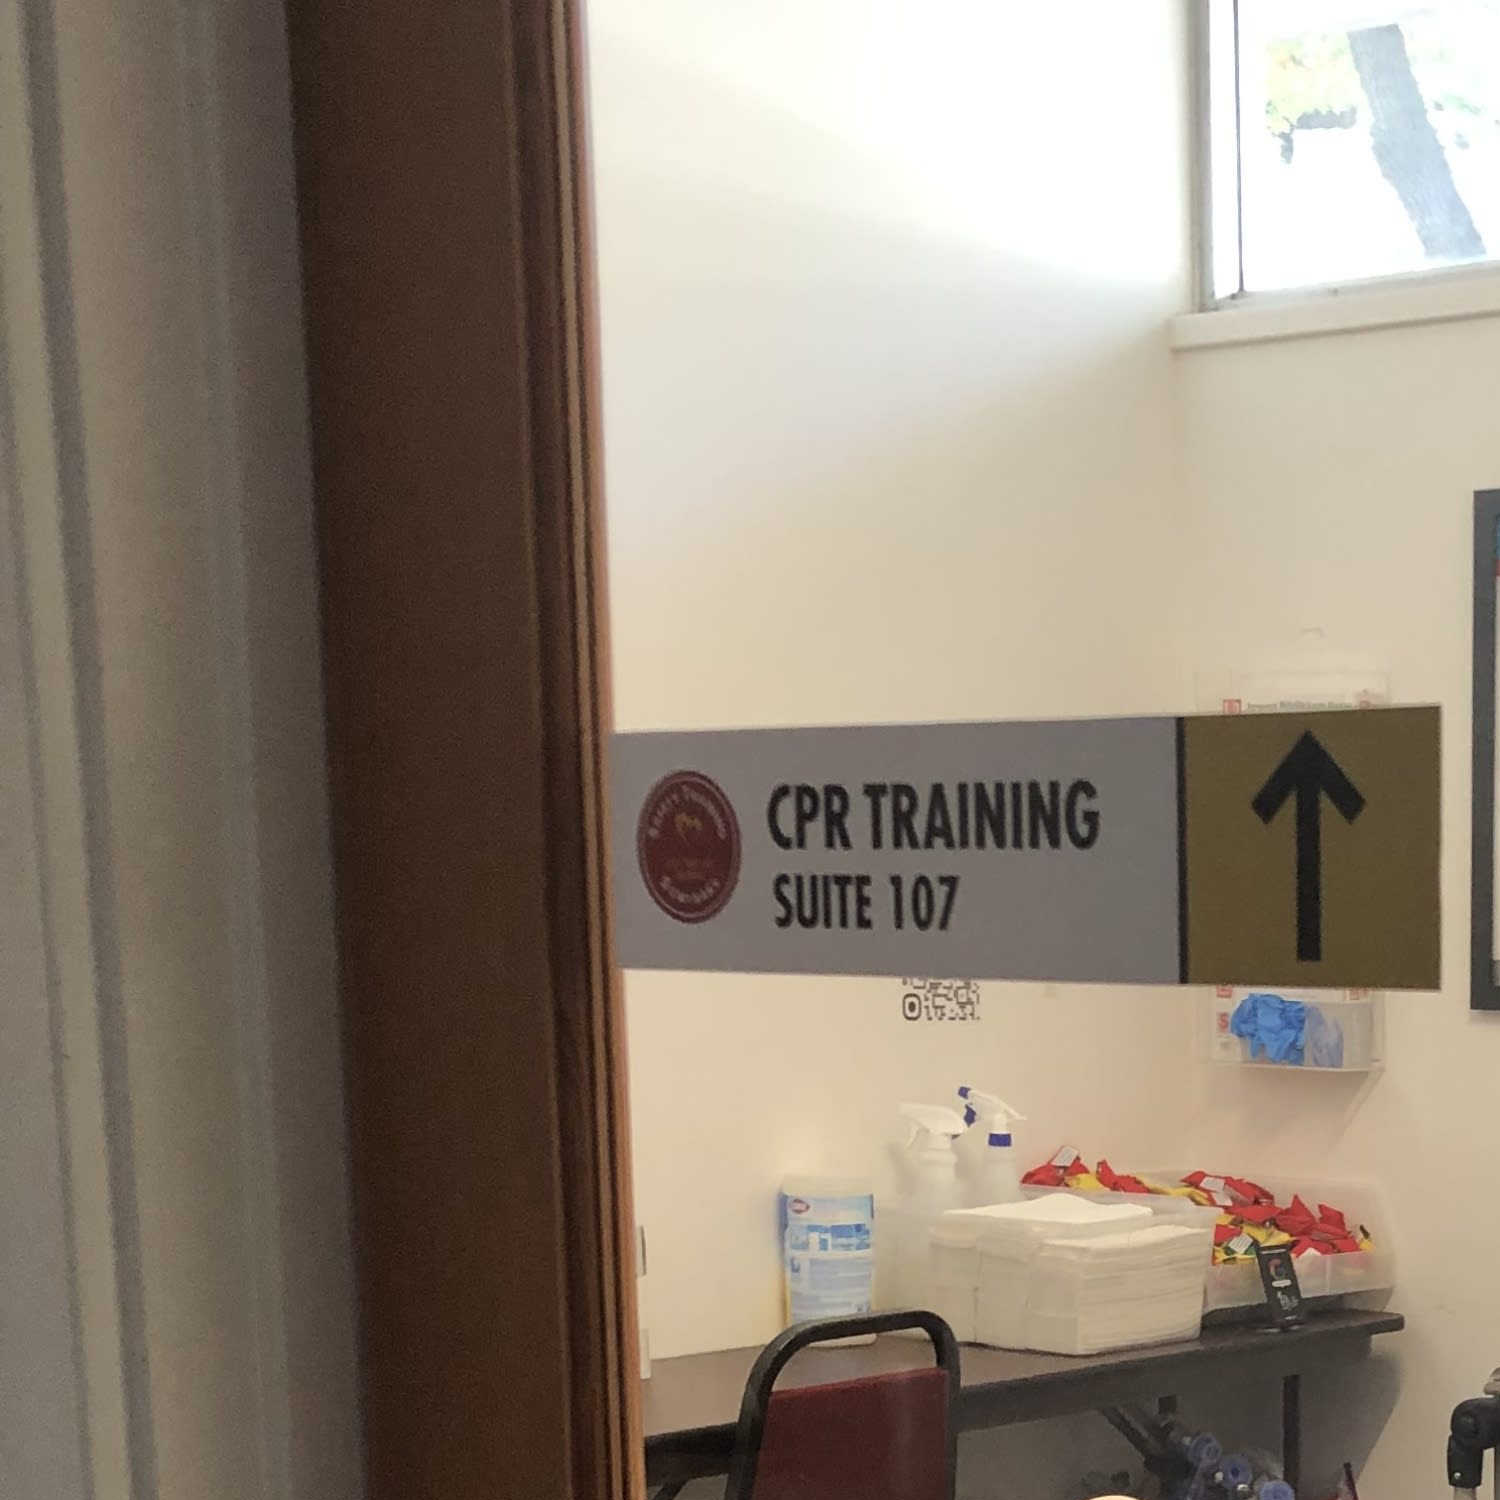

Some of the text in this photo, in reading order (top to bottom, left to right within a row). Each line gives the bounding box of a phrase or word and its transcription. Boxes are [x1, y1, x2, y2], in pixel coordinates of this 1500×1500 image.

[767, 783, 851, 851] CPR
[866, 779, 1099, 850] TRAINING
[774, 874, 872, 930] SUITE
[892, 874, 960, 930] 107
